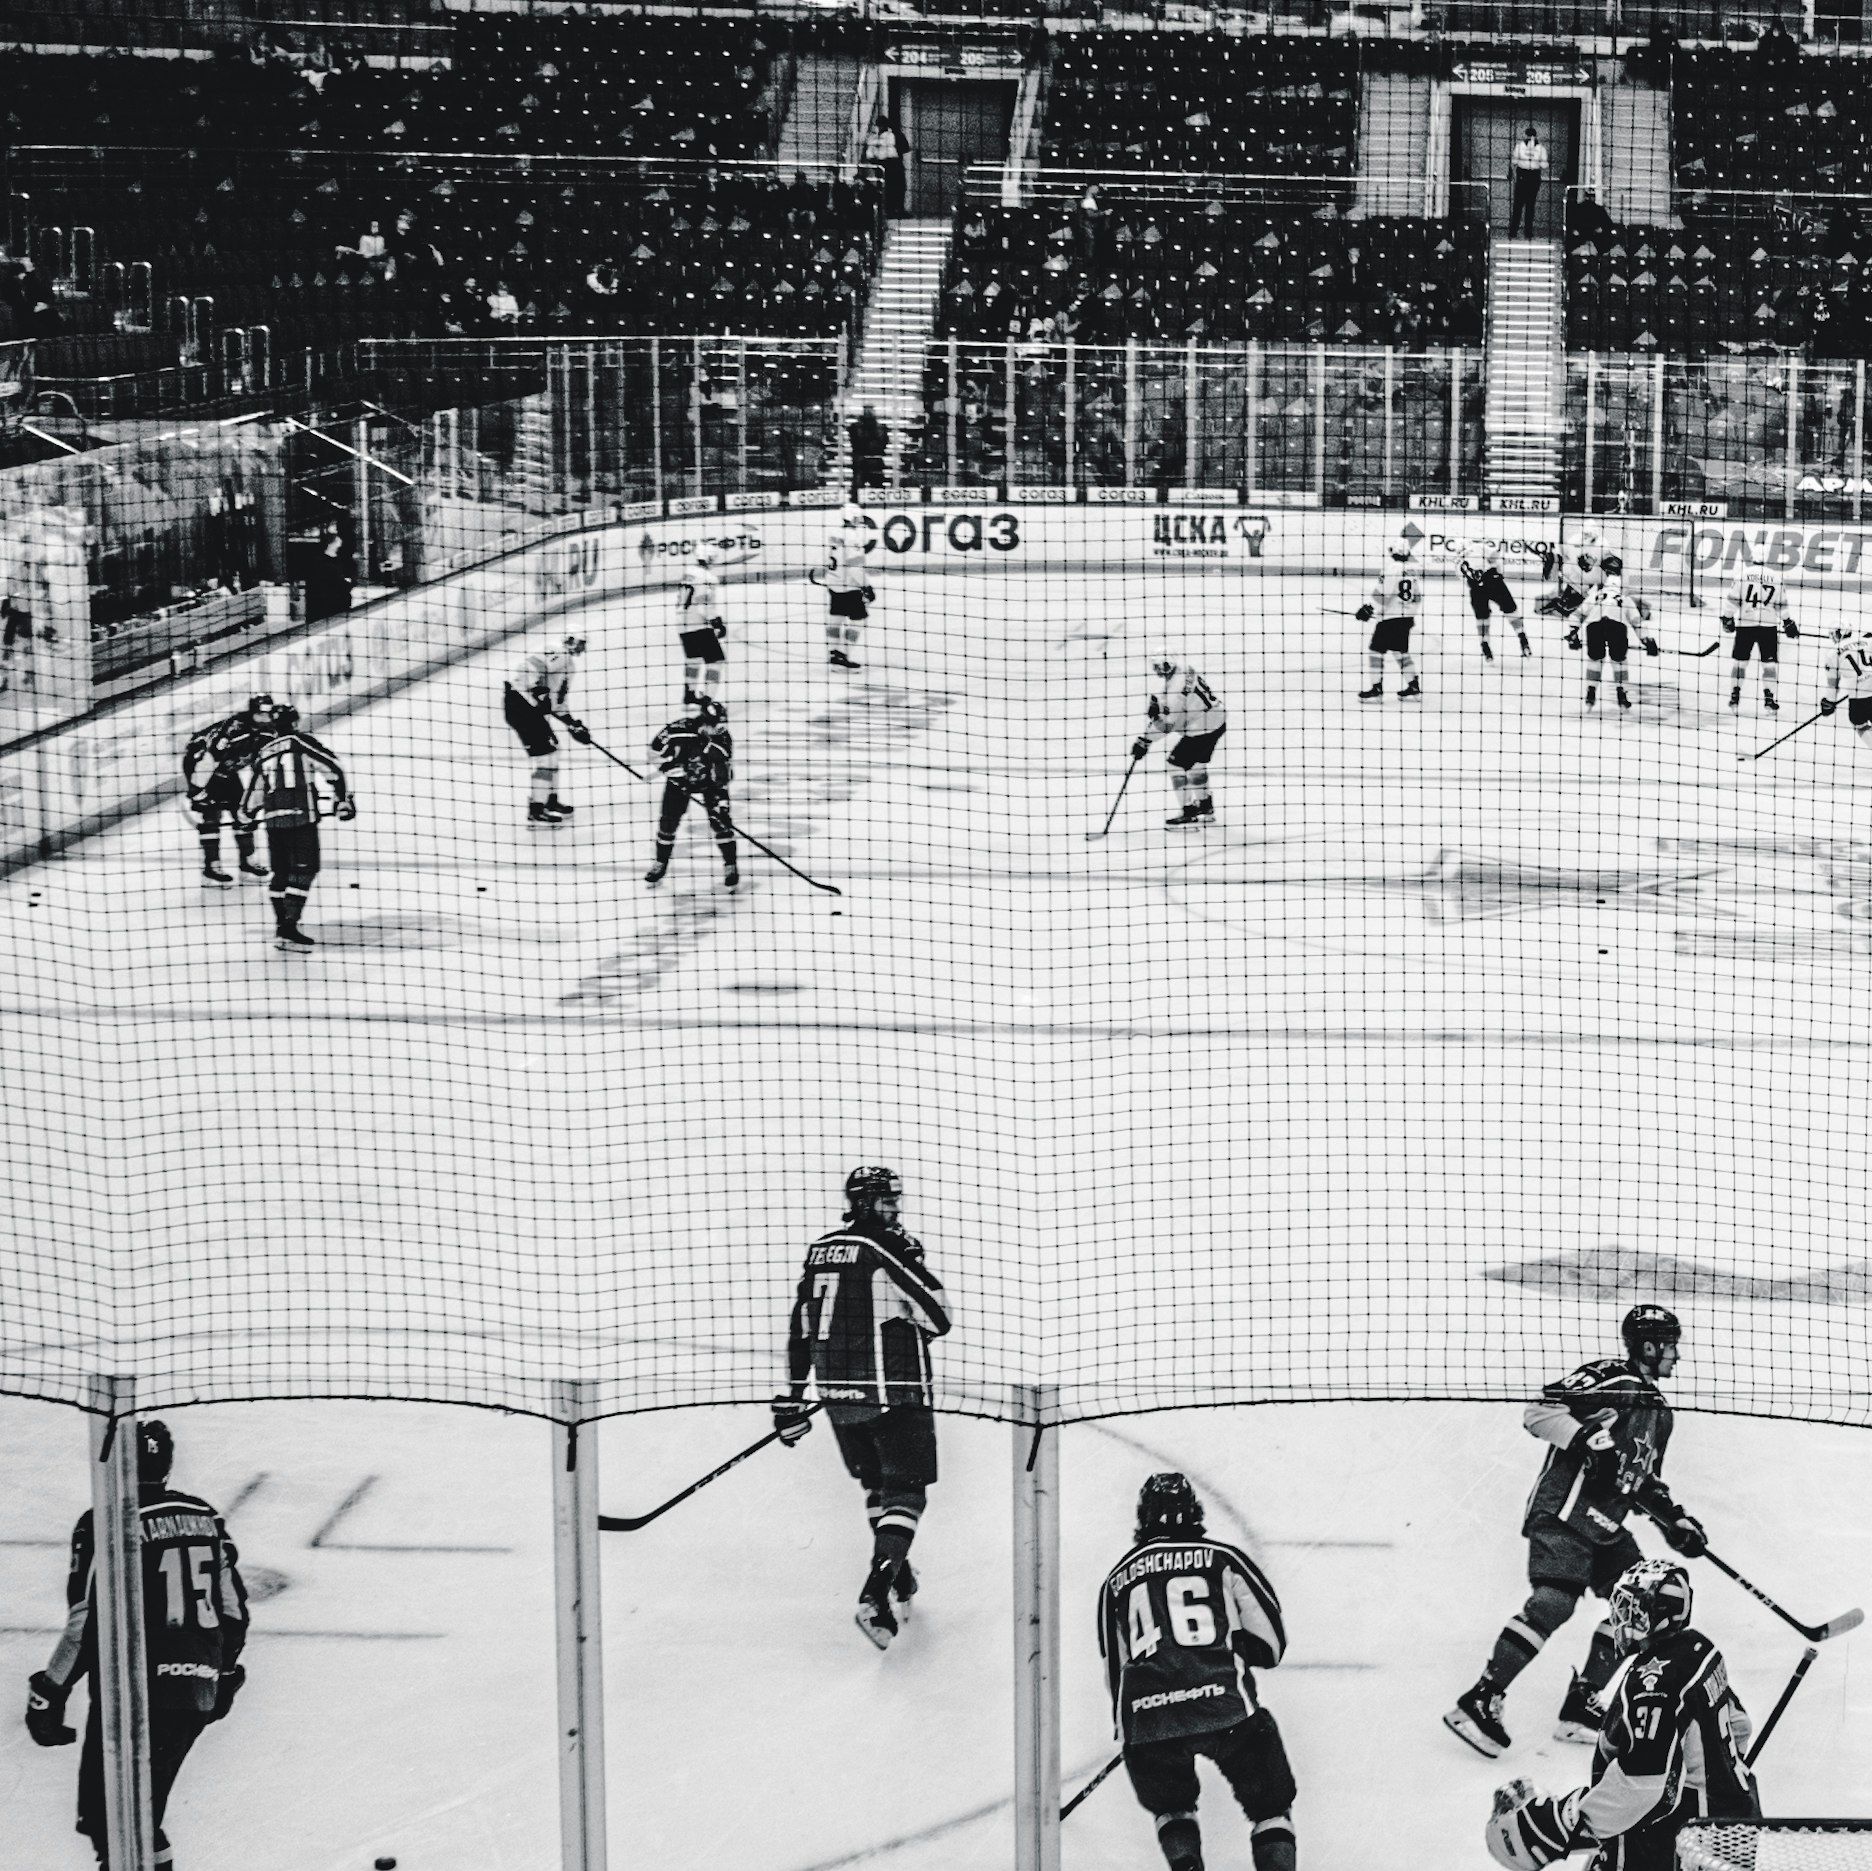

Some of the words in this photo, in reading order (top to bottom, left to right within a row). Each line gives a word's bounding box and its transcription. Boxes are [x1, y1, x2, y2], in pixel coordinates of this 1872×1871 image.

[1419, 497, 1469, 509] KHL.RU
[1502, 498, 1551, 510] KHL.RU
[1667, 504, 1719, 516] KHL.RU
[1154, 514, 1227, 546] ЦСКА
[1746, 584, 1775, 608] 47
[813, 1272, 840, 1340] 7
[159, 1546, 219, 1628] 15
[1128, 1575, 1216, 1660] 46
[1132, 1683, 1225, 1713] РОСНЕФТЬ
[1635, 1706, 1662, 1740] 31
